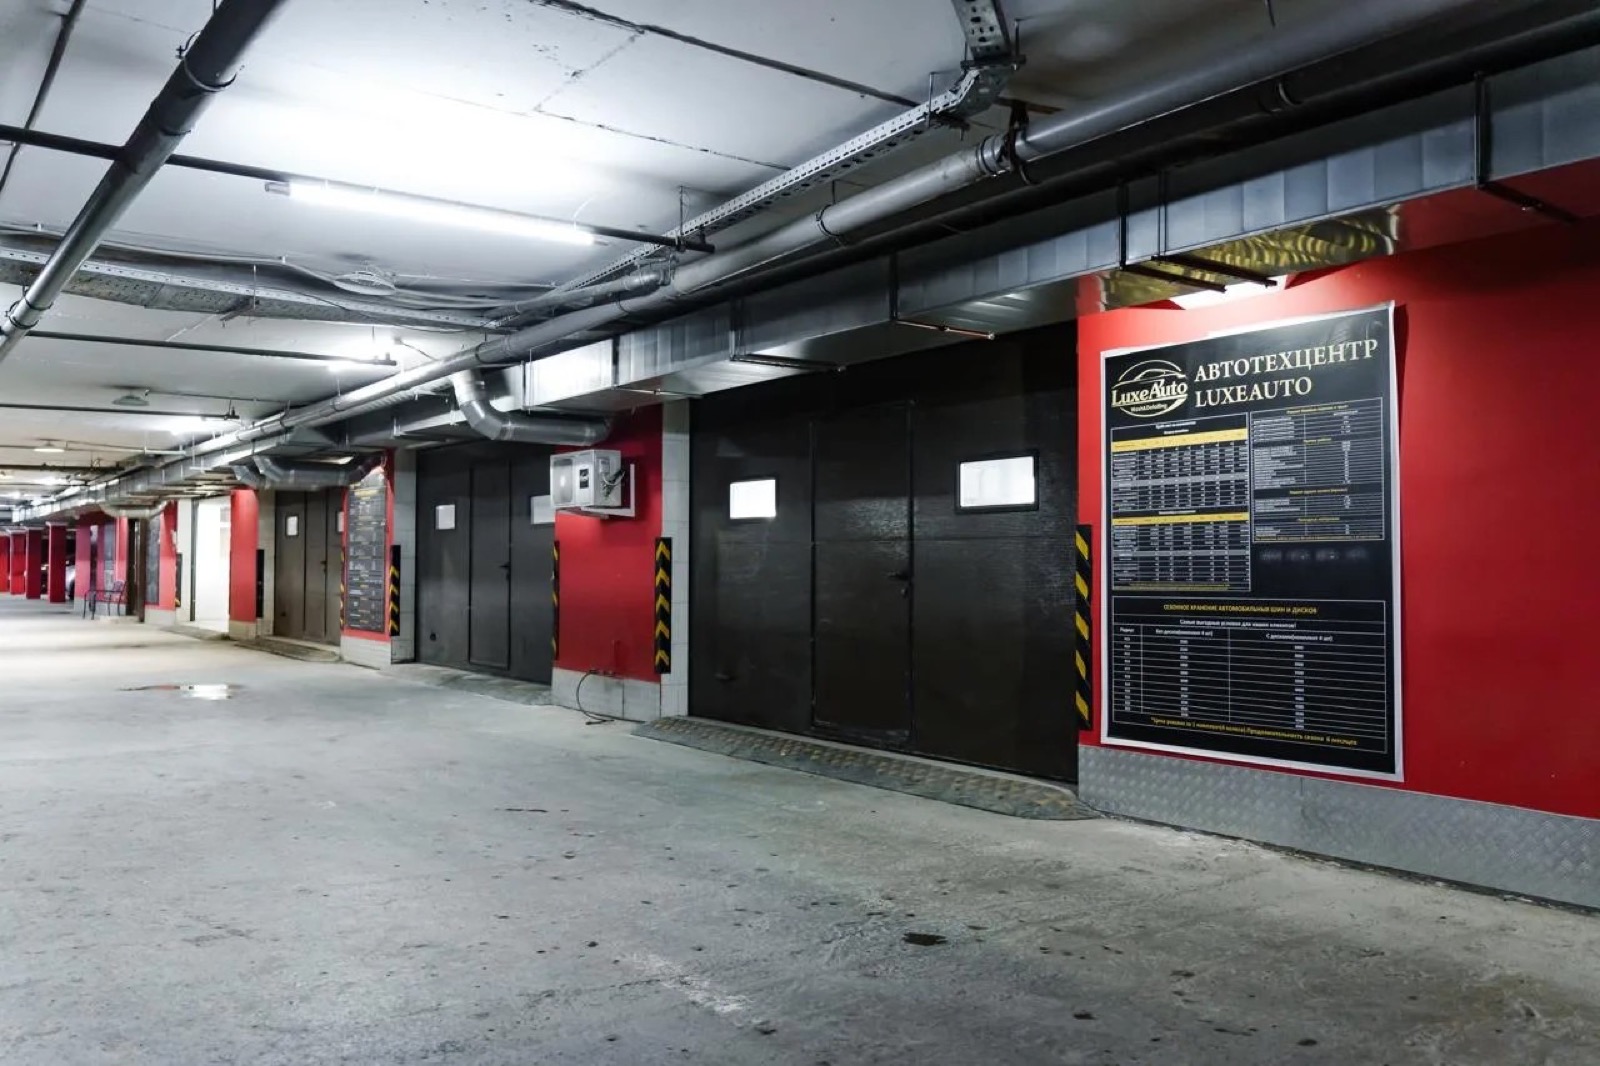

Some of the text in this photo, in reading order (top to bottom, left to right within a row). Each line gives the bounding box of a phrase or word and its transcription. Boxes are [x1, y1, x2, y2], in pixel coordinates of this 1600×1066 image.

[1194, 338, 1379, 384] АВТОТЕХЦЕНТР
[1110, 379, 1189, 408] LuxeAuto
[1195, 376, 1313, 408] LUXEAUTO
[1190, 604, 1217, 612] ХРАНЕНИЕ
[1292, 607, 1317, 615] ДИСКОВ
